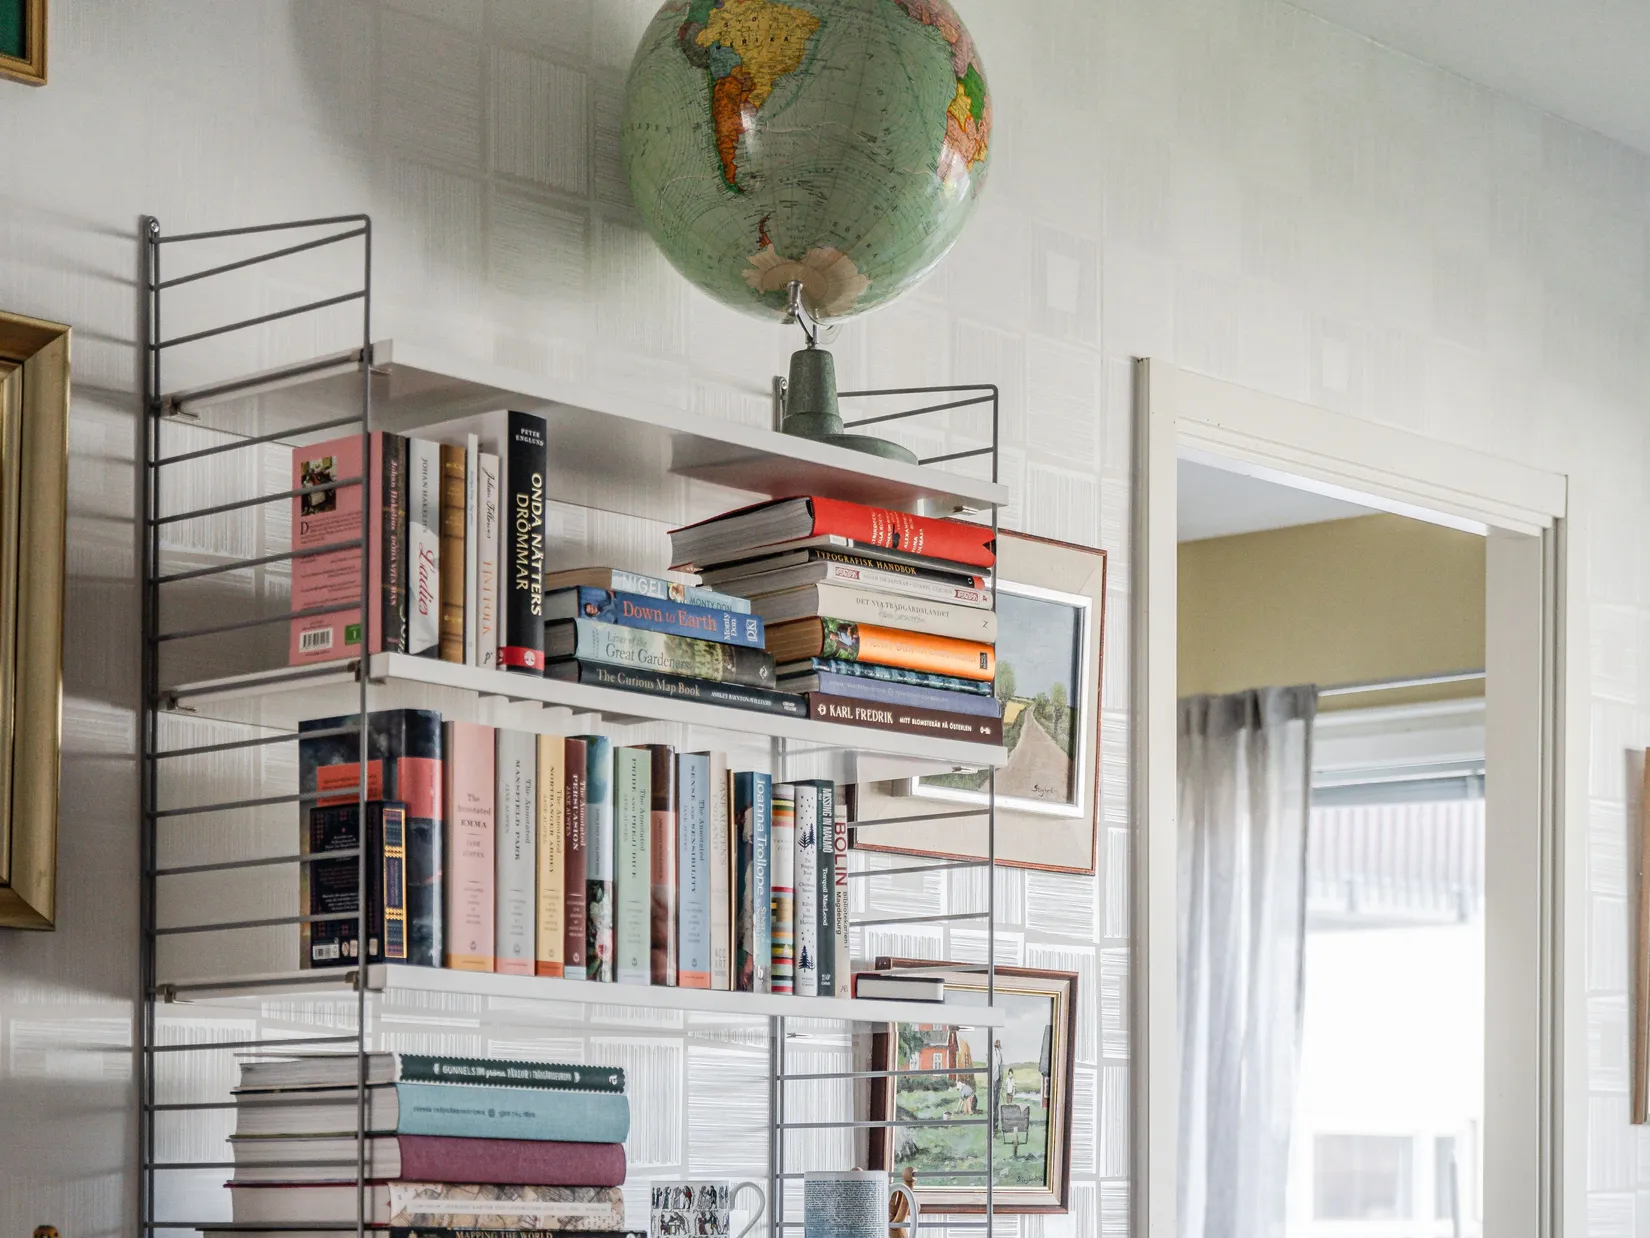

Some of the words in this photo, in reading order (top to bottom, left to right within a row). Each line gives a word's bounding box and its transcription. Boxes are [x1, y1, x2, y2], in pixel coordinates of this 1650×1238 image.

[516, 435, 544, 446] ENGLUND
[521, 428, 540, 438] PETER
[532, 473, 542, 507] ONDA
[516, 493, 530, 590] DRÖMMAR
[531, 534, 543, 616] NÄTTERS
[816, 551, 874, 568] TYPOGRAFISK
[876, 561, 917, 575] HANDBOK
[418, 542, 434, 616] Ladies
[622, 573, 665, 596] NIGEL
[623, 600, 663, 621] Down
[666, 612, 675, 624] to
[678, 610, 717, 631] Earth
[690, 598, 715, 608] MONTY
[716, 603, 732, 612] DON
[856, 597, 869, 605] DET
[871, 599, 884, 608] NYA
[724, 613, 732, 641] Monty
[746, 619, 758, 642] DK
[606, 643, 635, 661] Great
[638, 648, 694, 670] Gardeners
[597, 668, 615, 684] The
[618, 673, 654, 690] Curious
[656, 679, 676, 694] Map
[678, 682, 700, 697] Book
[829, 705, 853, 718] KARL
[856, 708, 893, 724] FREDRIK
[467, 794, 480, 802] The
[756, 779, 767, 831] Joanna
[822, 788, 832, 816] MISSING
[461, 820, 487, 829] EMMA
[823, 817, 832, 825] IN
[823, 826, 833, 853] MALMÖ
[755, 834, 767, 896] Trollope
[835, 822, 847, 886] BOLIN
[443, 1065, 475, 1076] GUNNELS
